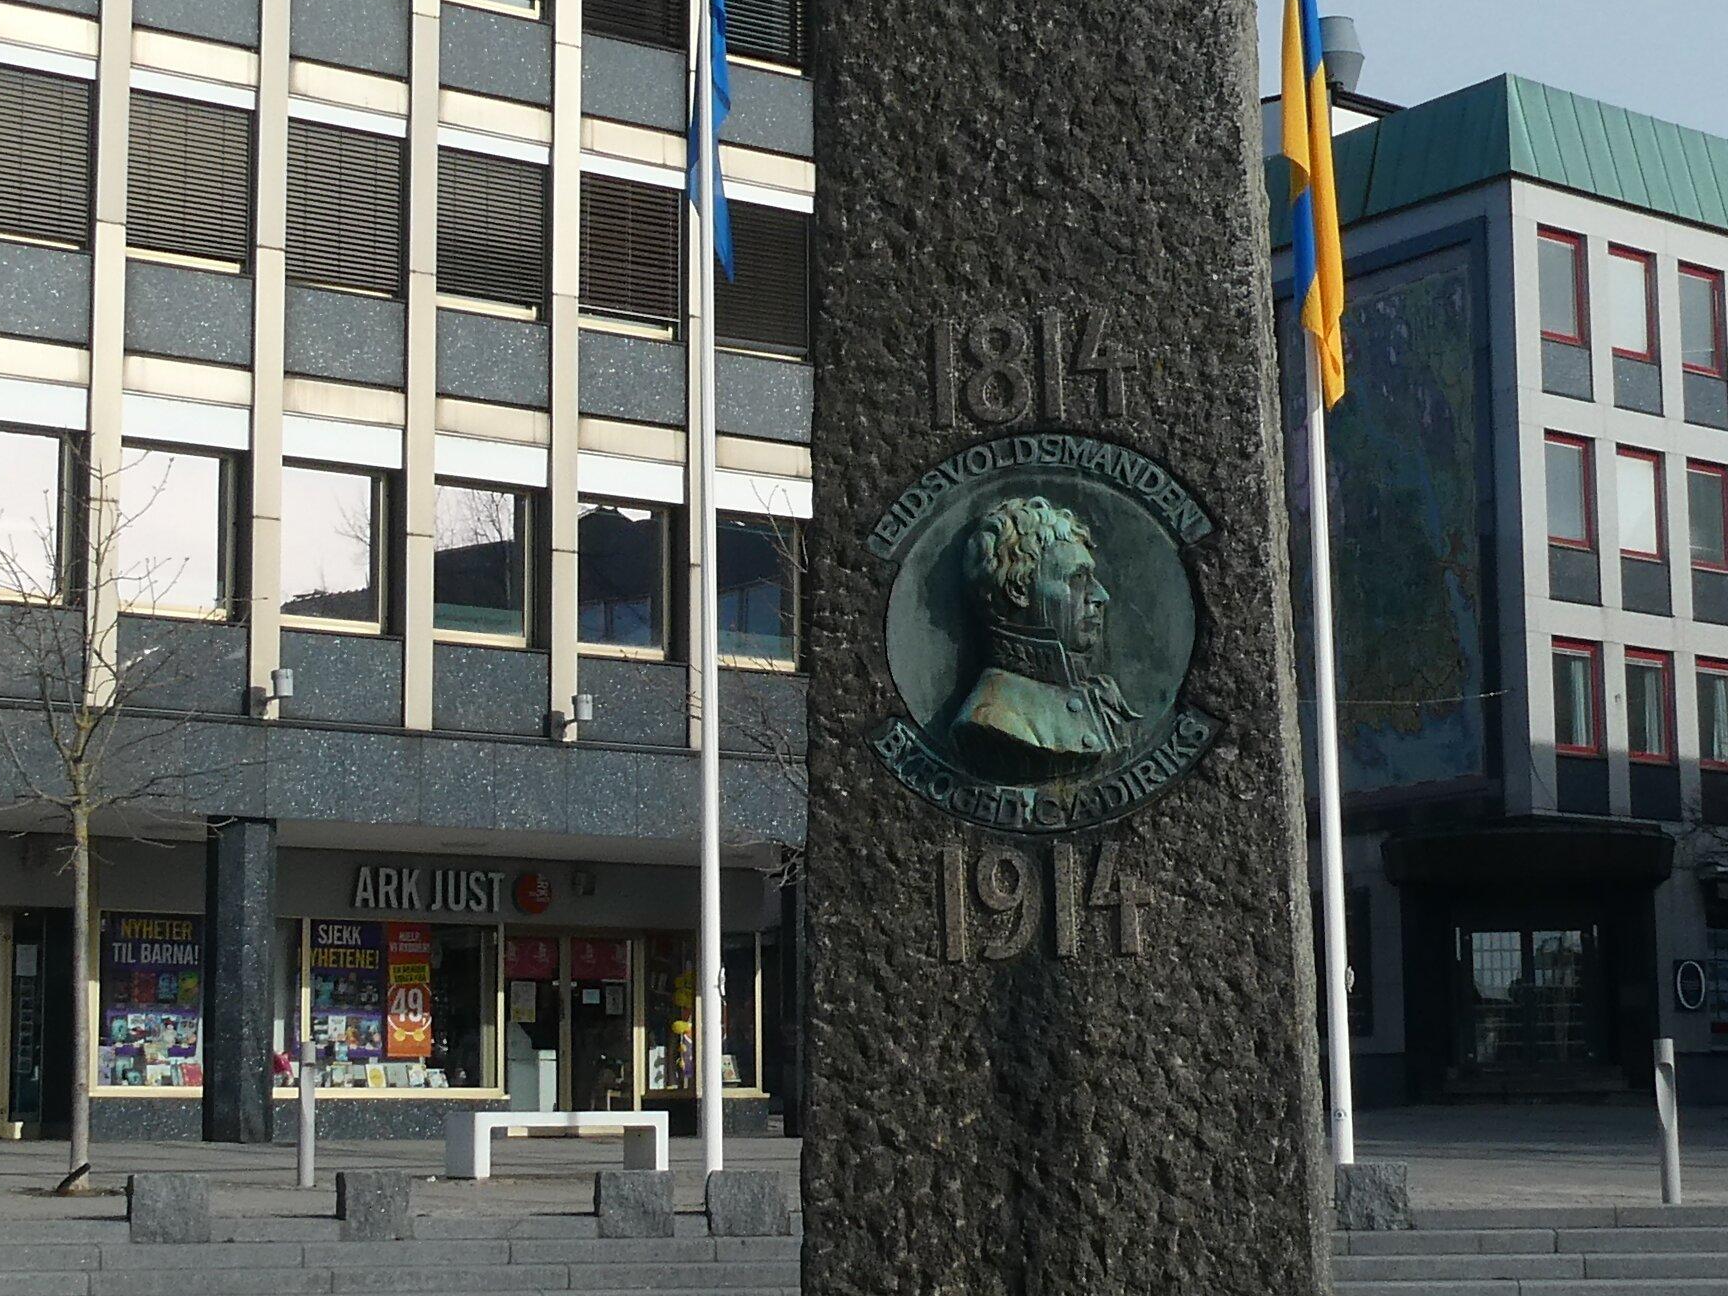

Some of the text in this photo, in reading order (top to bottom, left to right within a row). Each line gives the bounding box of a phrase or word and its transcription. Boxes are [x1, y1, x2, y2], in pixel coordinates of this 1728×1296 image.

[932, 308, 1138, 424] 1814
[874, 434, 1204, 546] EIDSVOLDSMANDEN
[355, 866, 506, 913] ARK JUST
[941, 842, 1153, 962] 1914
[120, 919, 194, 940] NYHETER
[317, 924, 363, 945] SJEKK
[112, 942, 200, 966] TIL BARNA!
[299, 949, 380, 970] YHETENE!
